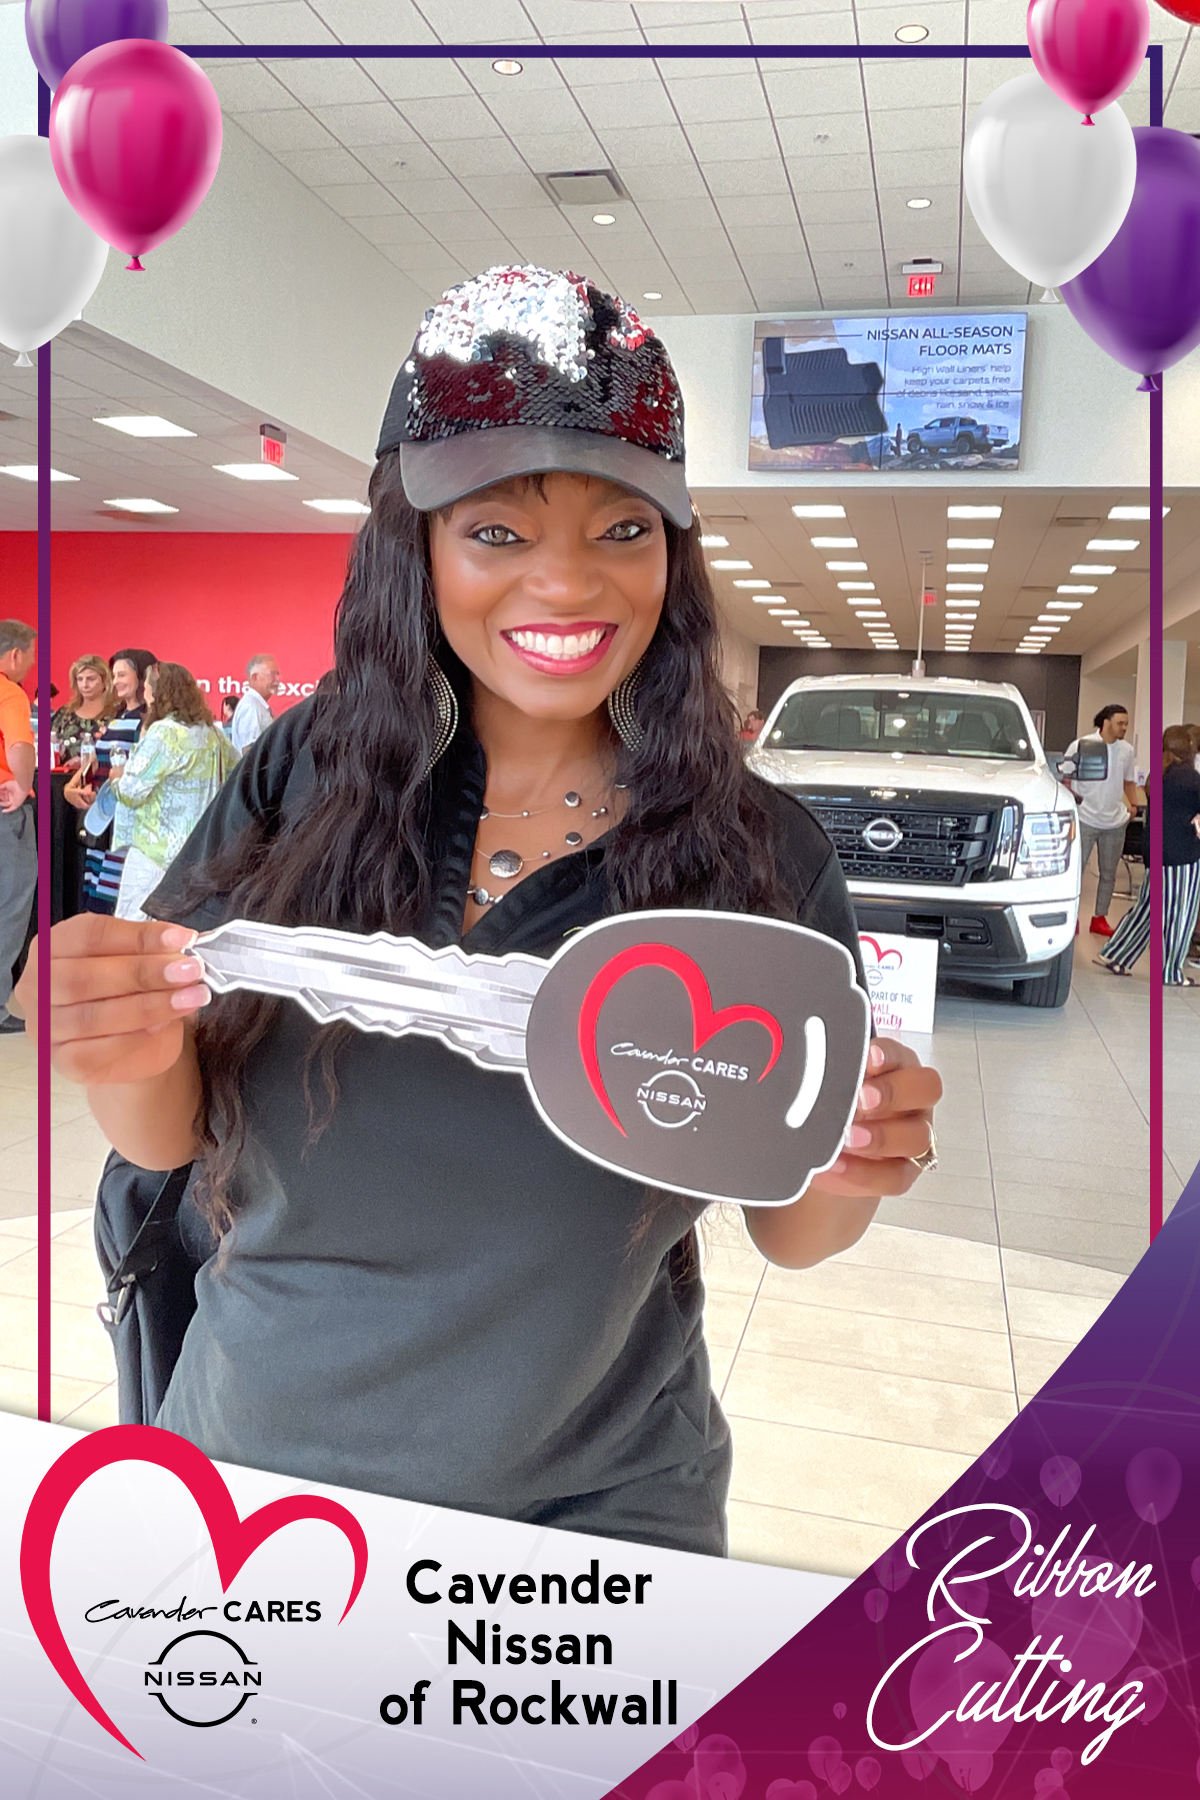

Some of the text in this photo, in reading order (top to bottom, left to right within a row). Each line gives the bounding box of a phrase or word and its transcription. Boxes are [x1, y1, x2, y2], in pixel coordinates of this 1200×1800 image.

[867, 326, 1013, 341] NISSAN ALL-SEASON
[919, 343, 1012, 356] FLOOR MATS
[912, 366, 933, 376] High
[936, 365, 955, 374] Wall
[990, 364, 1012, 374] help
[904, 376, 1011, 387] keep your carpets free
[986, 400, 994, 409] &
[871, 990, 914, 1004] PART OF THE
[871, 1003, 890, 1015] WALL
[875, 1014, 902, 1030] unity
[691, 1058, 749, 1081] CARES
[637, 1087, 707, 1110] NISSAN
